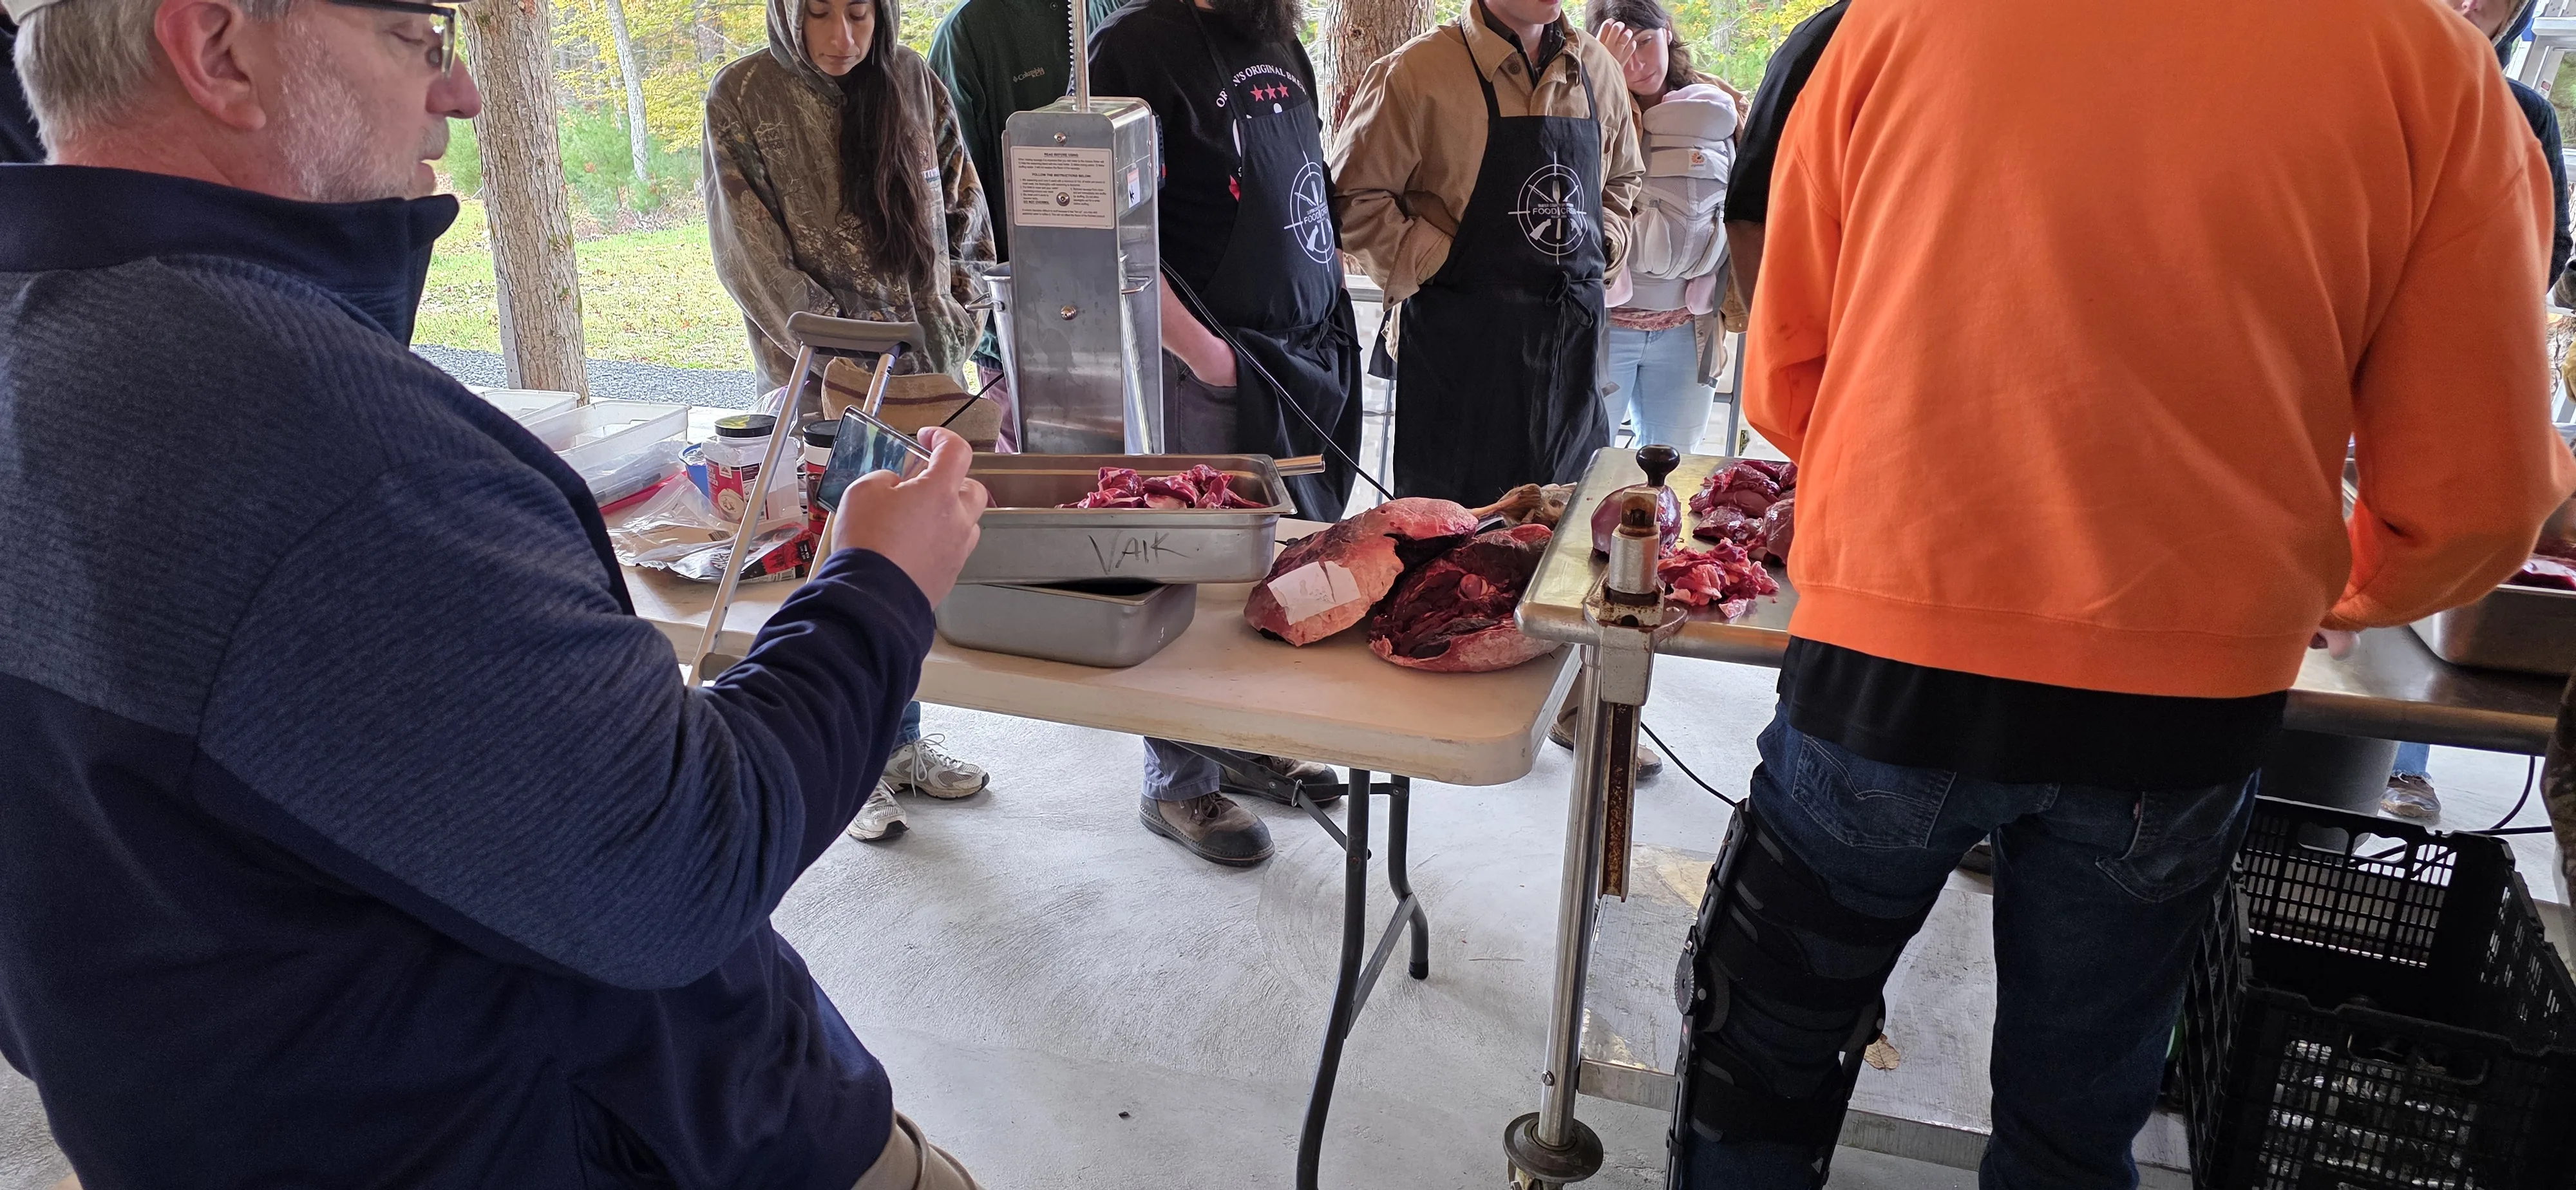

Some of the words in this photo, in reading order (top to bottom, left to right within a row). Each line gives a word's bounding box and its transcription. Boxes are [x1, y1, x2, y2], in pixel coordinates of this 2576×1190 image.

[1018, 67, 1044, 80] Columbia
[1245, 64, 1286, 77] ORIGINAL
[1304, 212, 1320, 224] FOOD
